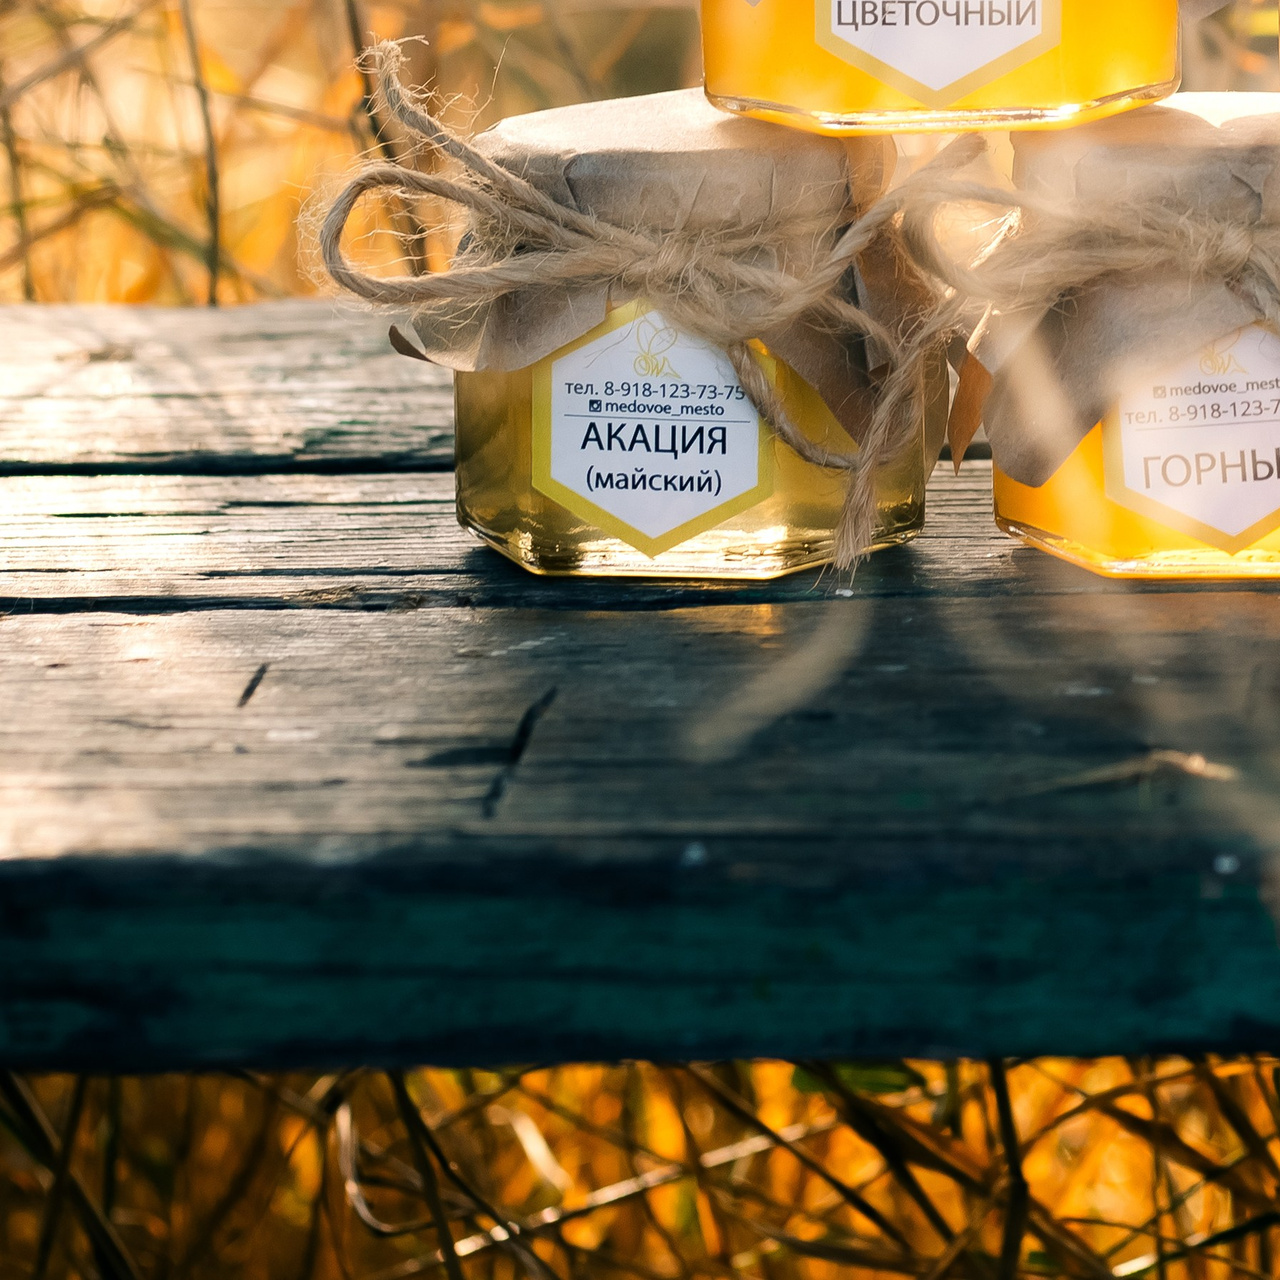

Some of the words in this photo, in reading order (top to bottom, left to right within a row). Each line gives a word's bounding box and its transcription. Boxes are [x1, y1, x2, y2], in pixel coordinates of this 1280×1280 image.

[565, 382, 599, 395] тел.
[604, 381, 745, 400] 8-918-123-73-75
[605, 400, 724, 416] medovoe_mesto
[1125, 410, 1163, 425] тел.
[581, 422, 727, 460] АКАЦИЯ
[586, 465, 722, 496] (майский)
